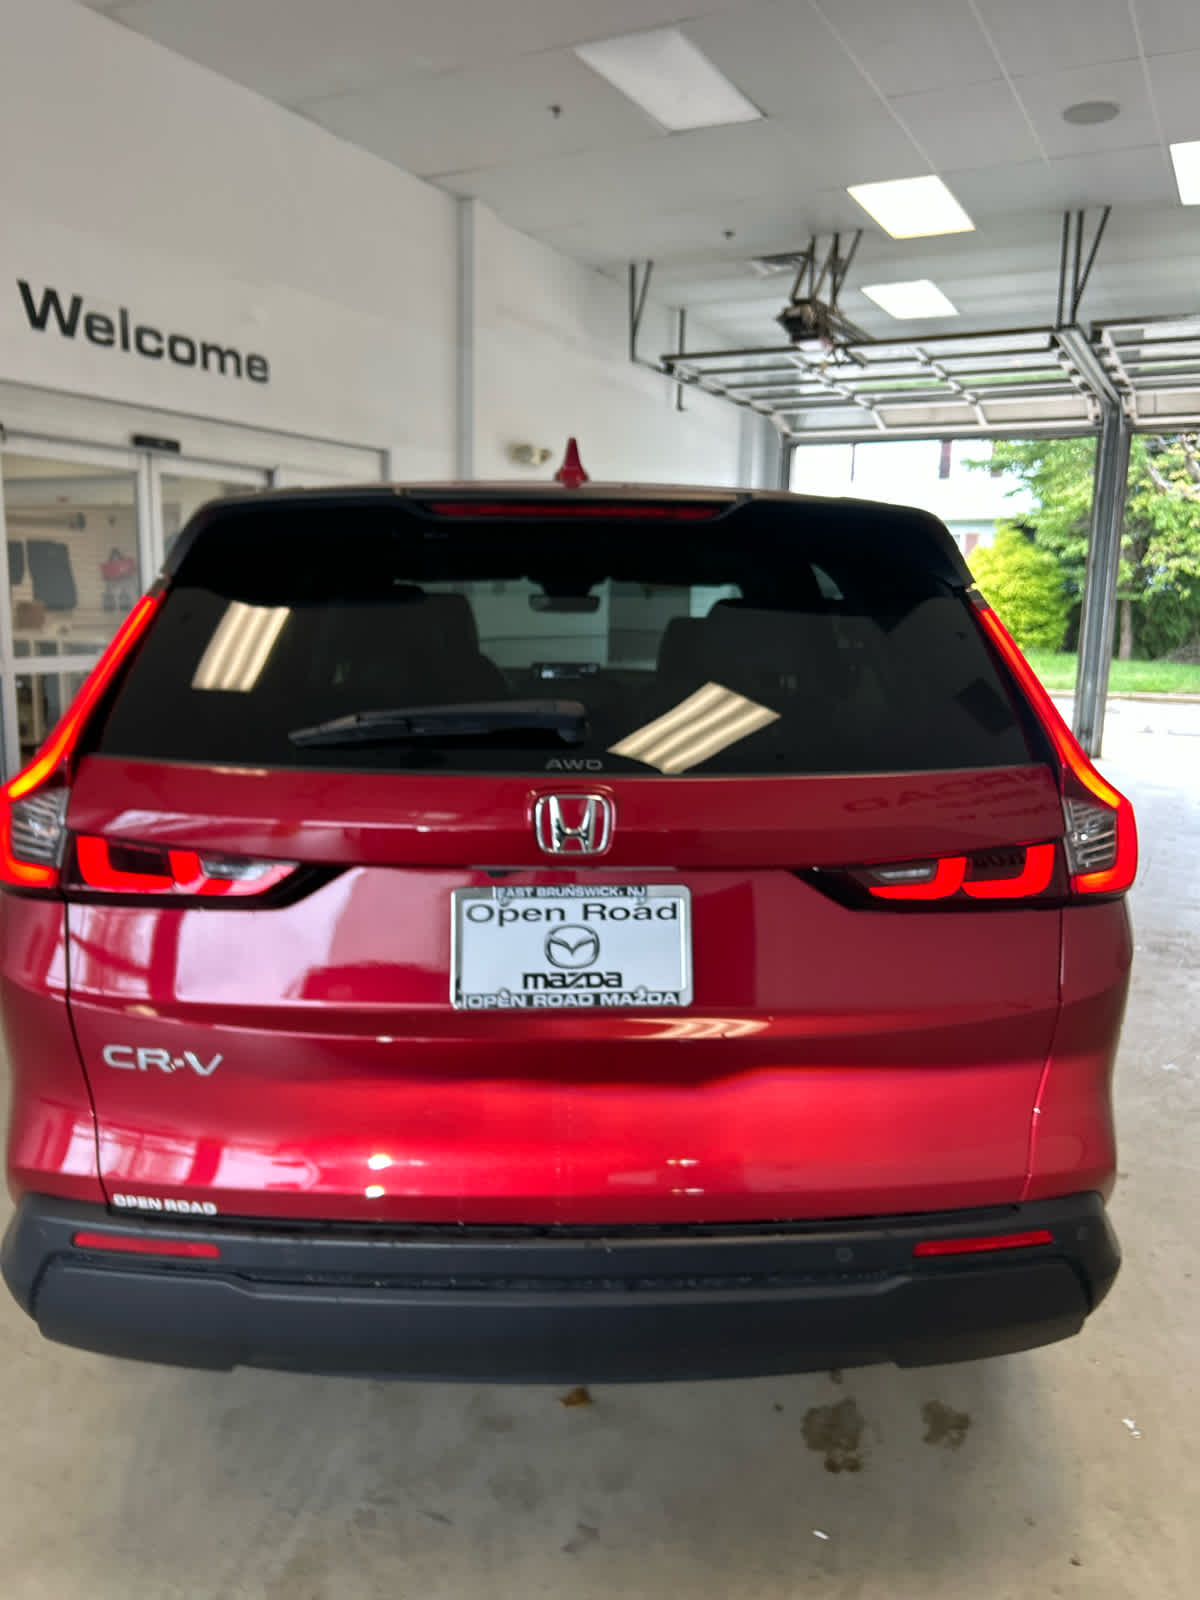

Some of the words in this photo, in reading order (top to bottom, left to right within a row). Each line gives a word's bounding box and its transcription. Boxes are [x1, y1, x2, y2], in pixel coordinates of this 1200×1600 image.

[16, 278, 270, 384] Welcome
[545, 759, 603, 770] AWD
[627, 886, 645, 897] NJ
[466, 903, 566, 927] Open
[582, 902, 678, 921] Road
[468, 993, 526, 1008] OPEN
[533, 993, 595, 1007] ROAD
[600, 991, 679, 1006] MAZDA
[103, 1044, 223, 1076] CR-V
[112, 1193, 162, 1210] OPEN
[164, 1198, 218, 1215] ROAD
